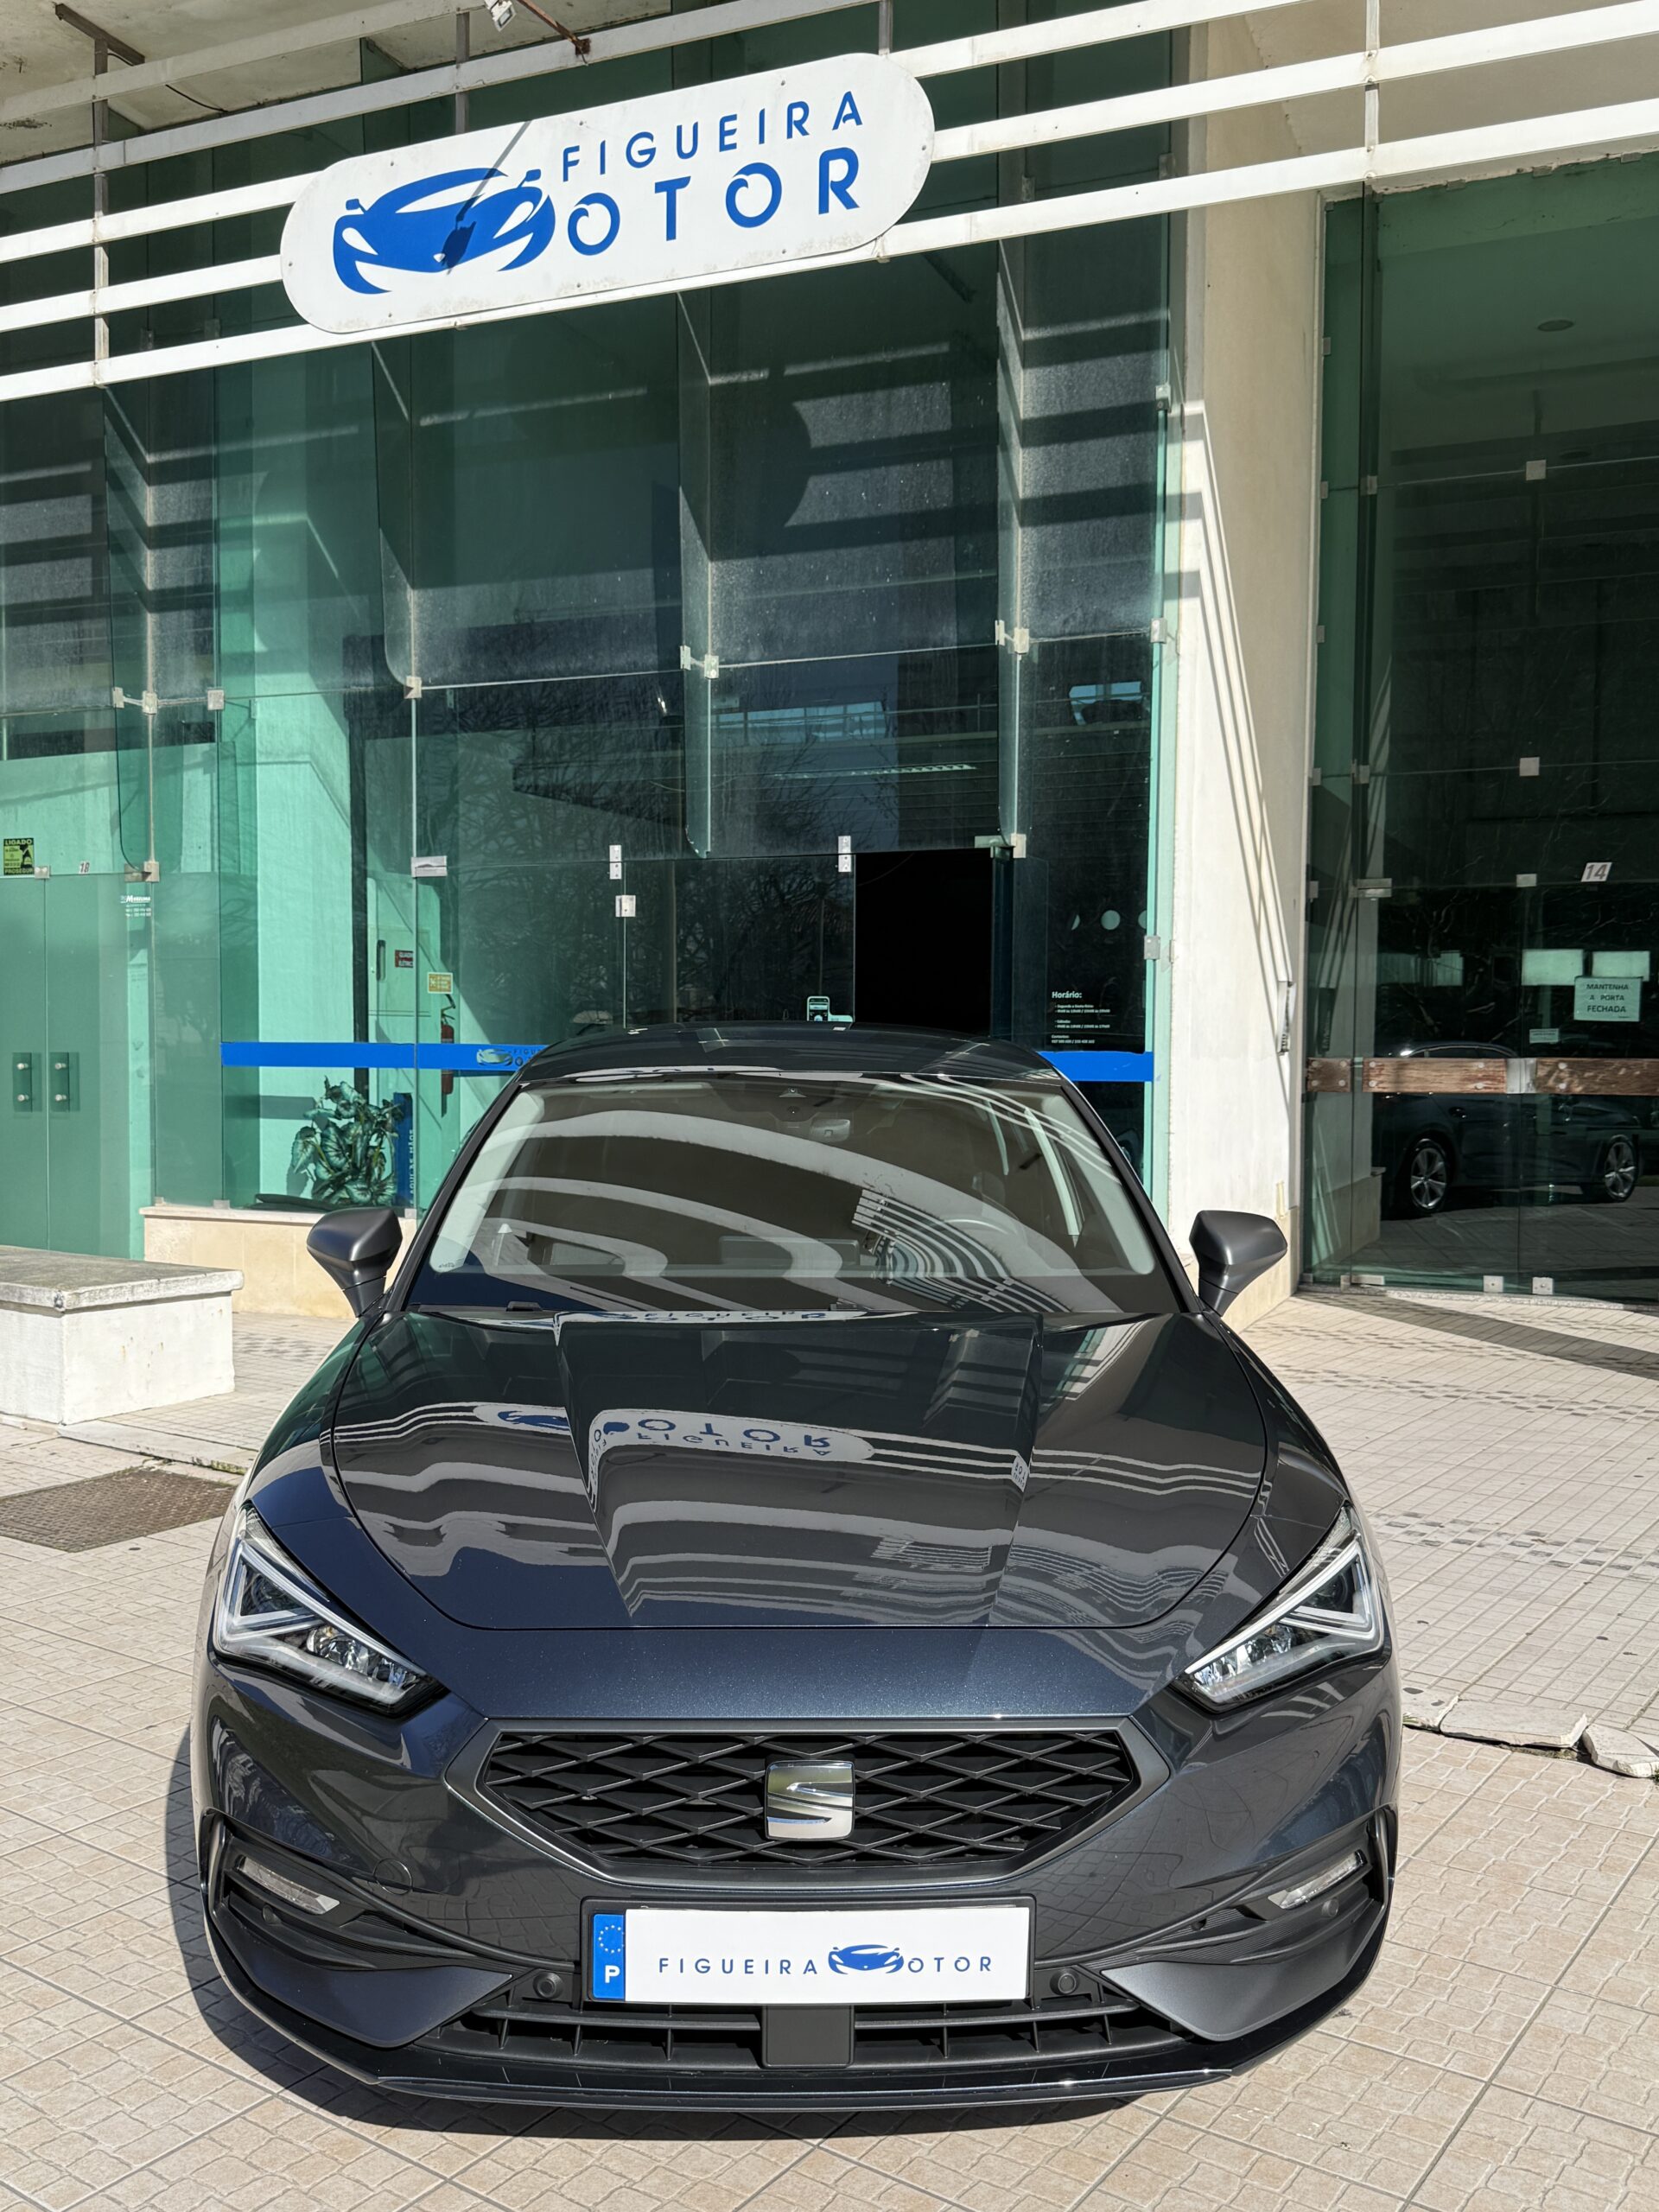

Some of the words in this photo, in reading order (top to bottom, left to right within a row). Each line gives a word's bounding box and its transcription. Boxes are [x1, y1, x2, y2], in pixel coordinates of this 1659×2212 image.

[563, 92, 862, 182] FIGUEIRA
[1586, 864, 1607, 880] 14
[605, 1965, 620, 1983] P
[658, 1957, 817, 1975] FIGUEIRA
